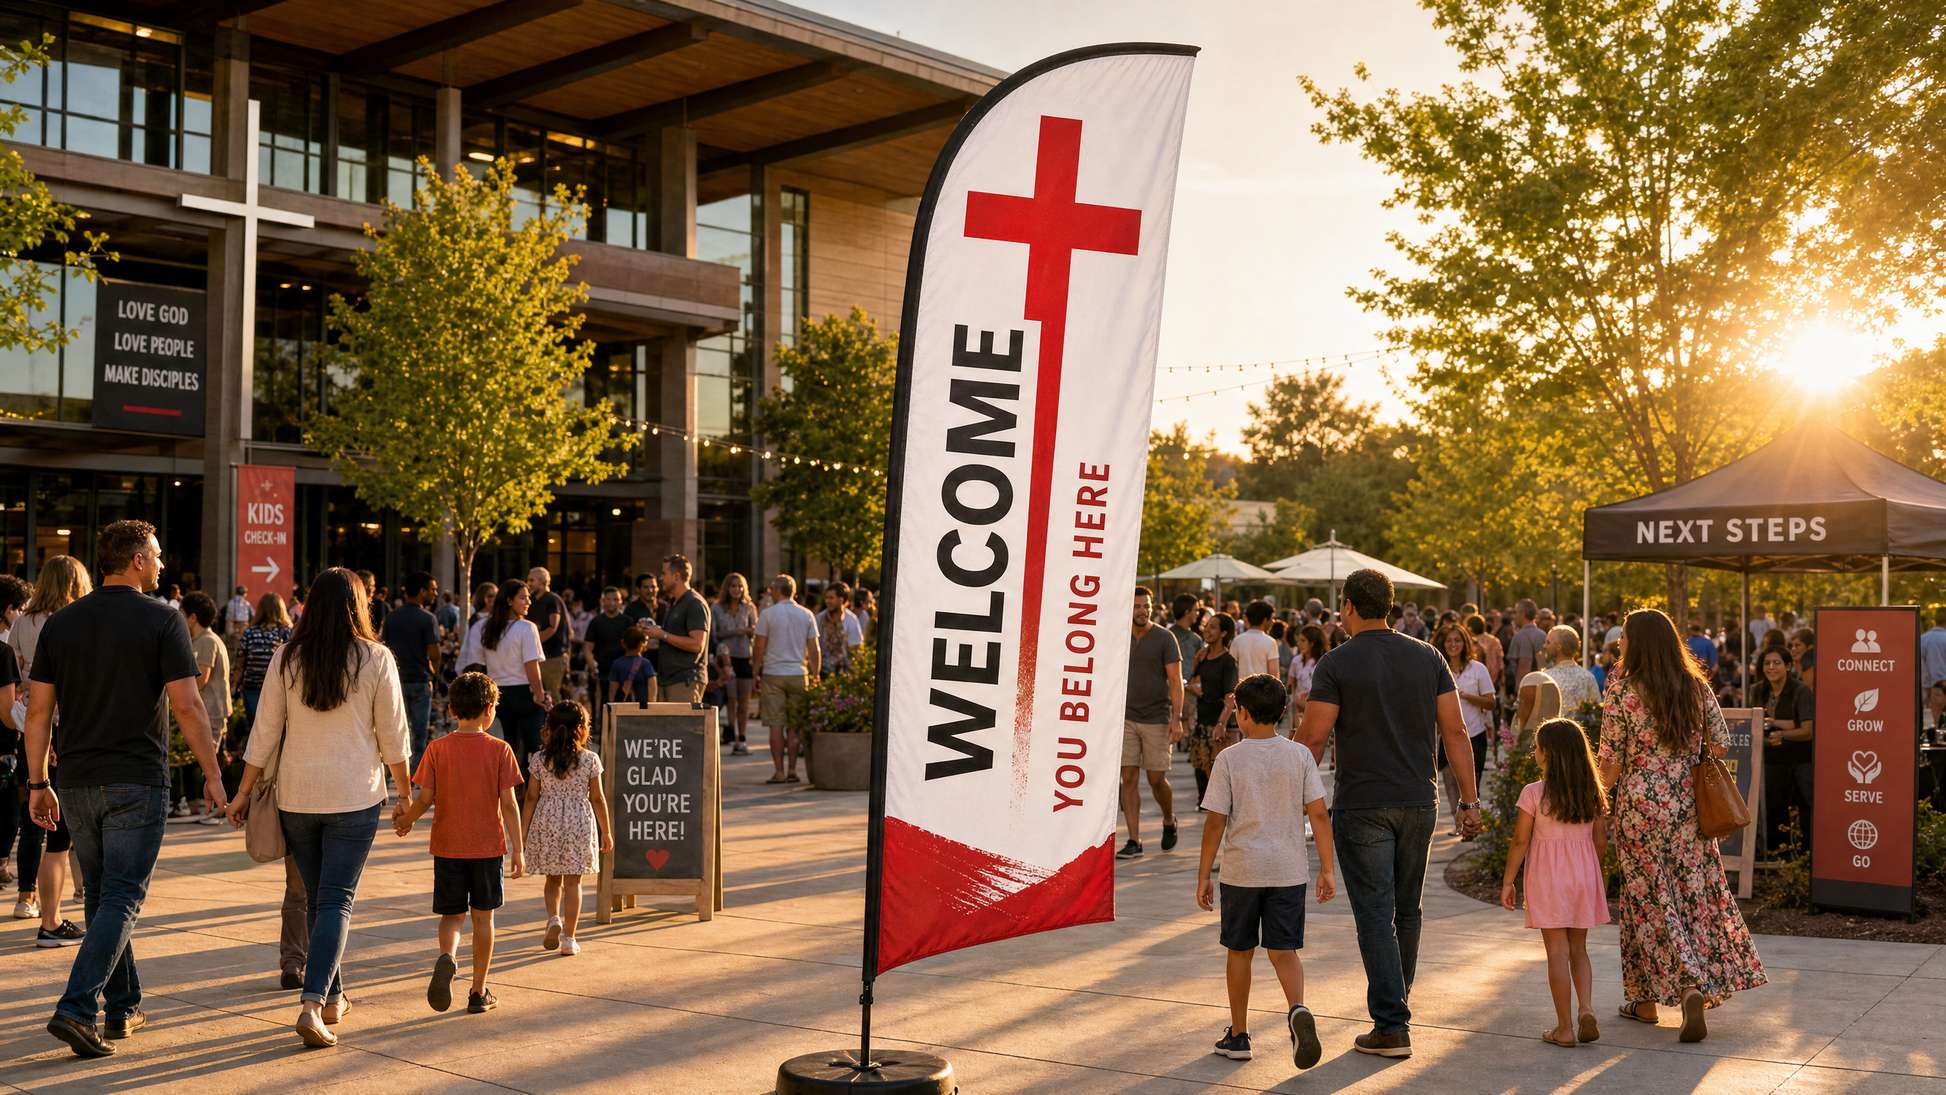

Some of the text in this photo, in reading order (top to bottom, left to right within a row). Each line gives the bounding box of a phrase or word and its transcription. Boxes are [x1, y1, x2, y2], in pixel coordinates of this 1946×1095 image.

[118, 300, 189, 325] LOVE GOD
[114, 332, 194, 358] LOVE PEOPLE
[104, 364, 199, 391] MAKE DISCIPLES
[247, 502, 284, 525] KIDS
[244, 530, 287, 545] CHECK-IN
[1637, 517, 1827, 544] NEXT STEPS
[925, 324, 1025, 781] WELCOME
[1053, 462, 1110, 812] YOU BELONG HERE
[1837, 659, 1896, 672] CONNECT
[1847, 719, 1884, 732] GROW
[623, 739, 683, 759] WE’RE
[626, 766, 677, 786] GLAD
[622, 793, 691, 814] YOU’RE
[1844, 789, 1883, 804] SERVE
[629, 820, 685, 841] HERE!
[1852, 854, 1871, 868] GO
